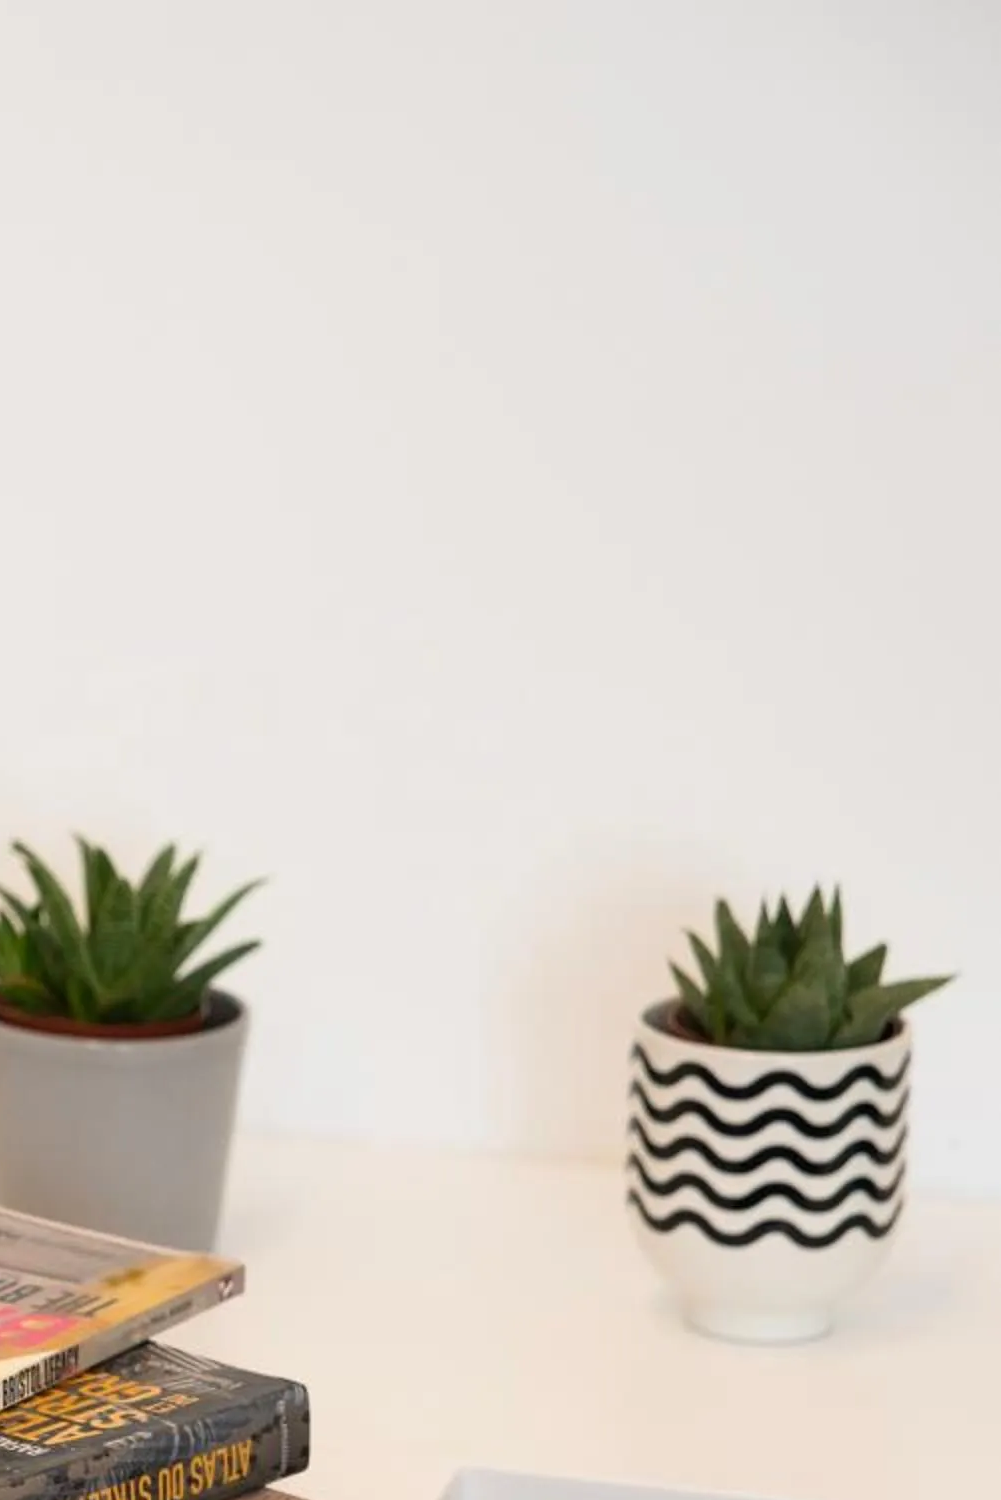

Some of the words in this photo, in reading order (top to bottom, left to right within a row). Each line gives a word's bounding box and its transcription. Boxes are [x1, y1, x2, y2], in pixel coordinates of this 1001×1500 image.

[31, 1289, 120, 1317] THE
[2, 1361, 43, 1408] BRISTOL
[157, 1460, 184, 1498] DU
[189, 1438, 254, 1496] ATLAS
